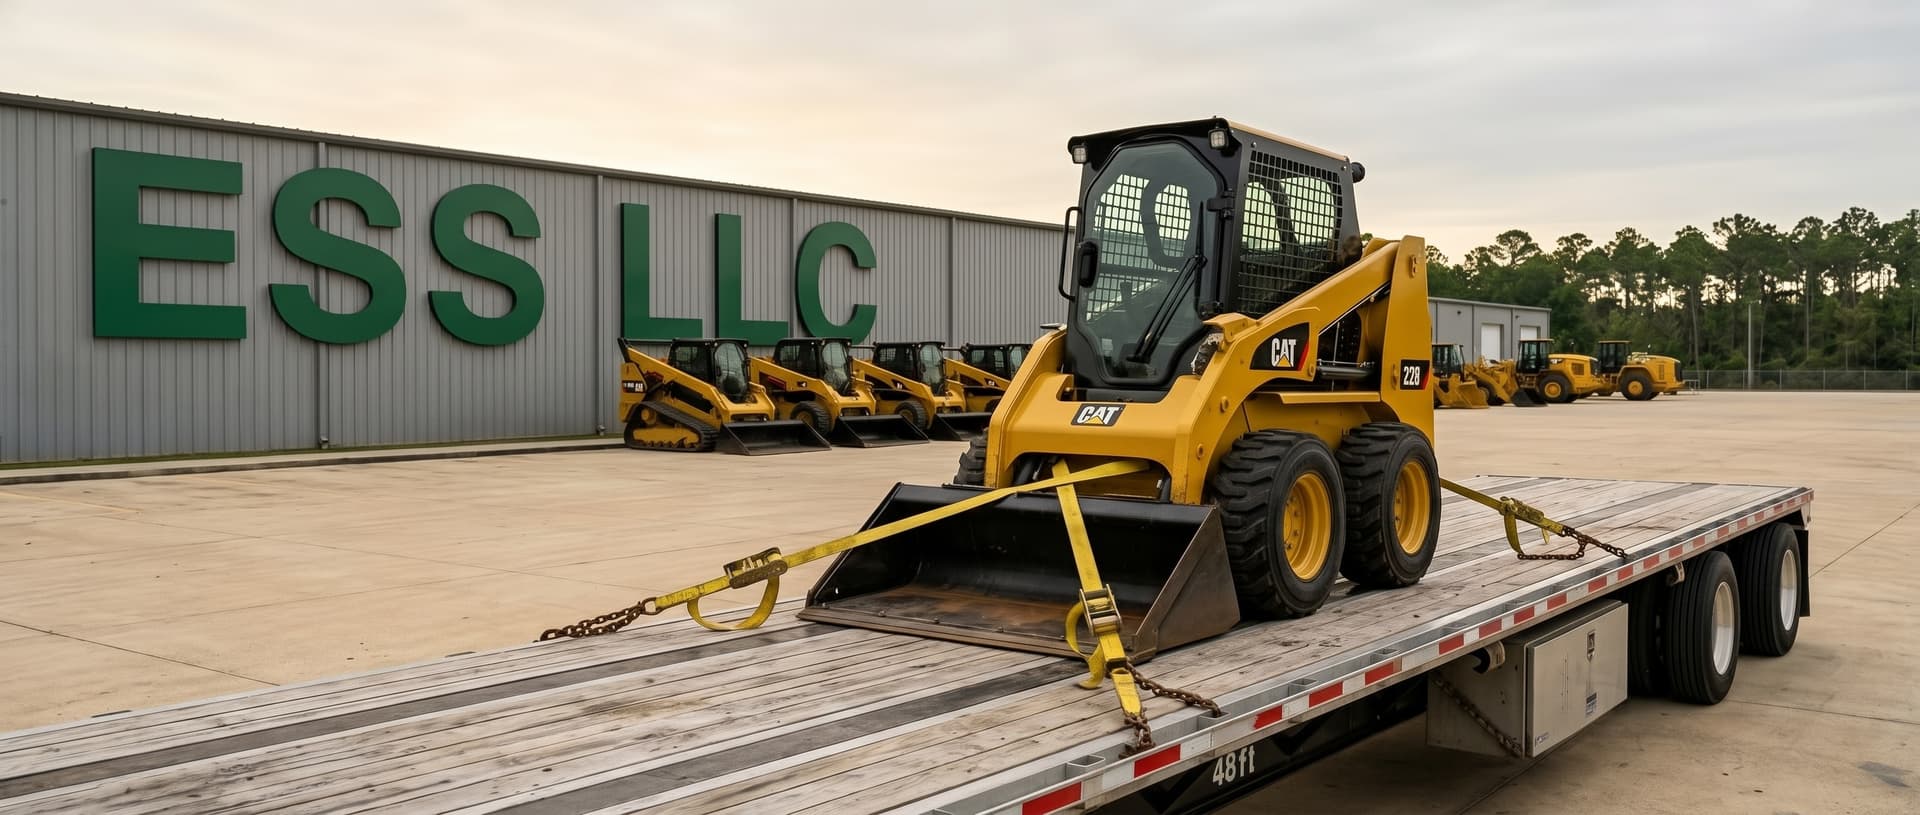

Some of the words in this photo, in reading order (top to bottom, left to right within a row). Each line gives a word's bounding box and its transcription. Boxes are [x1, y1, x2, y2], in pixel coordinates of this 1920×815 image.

[92, 147, 546, 347] ESS
[620, 202, 878, 343] LLC
[1271, 337, 1297, 368] CAT
[1403, 366, 1420, 386] 228
[1077, 406, 1120, 425] CAT
